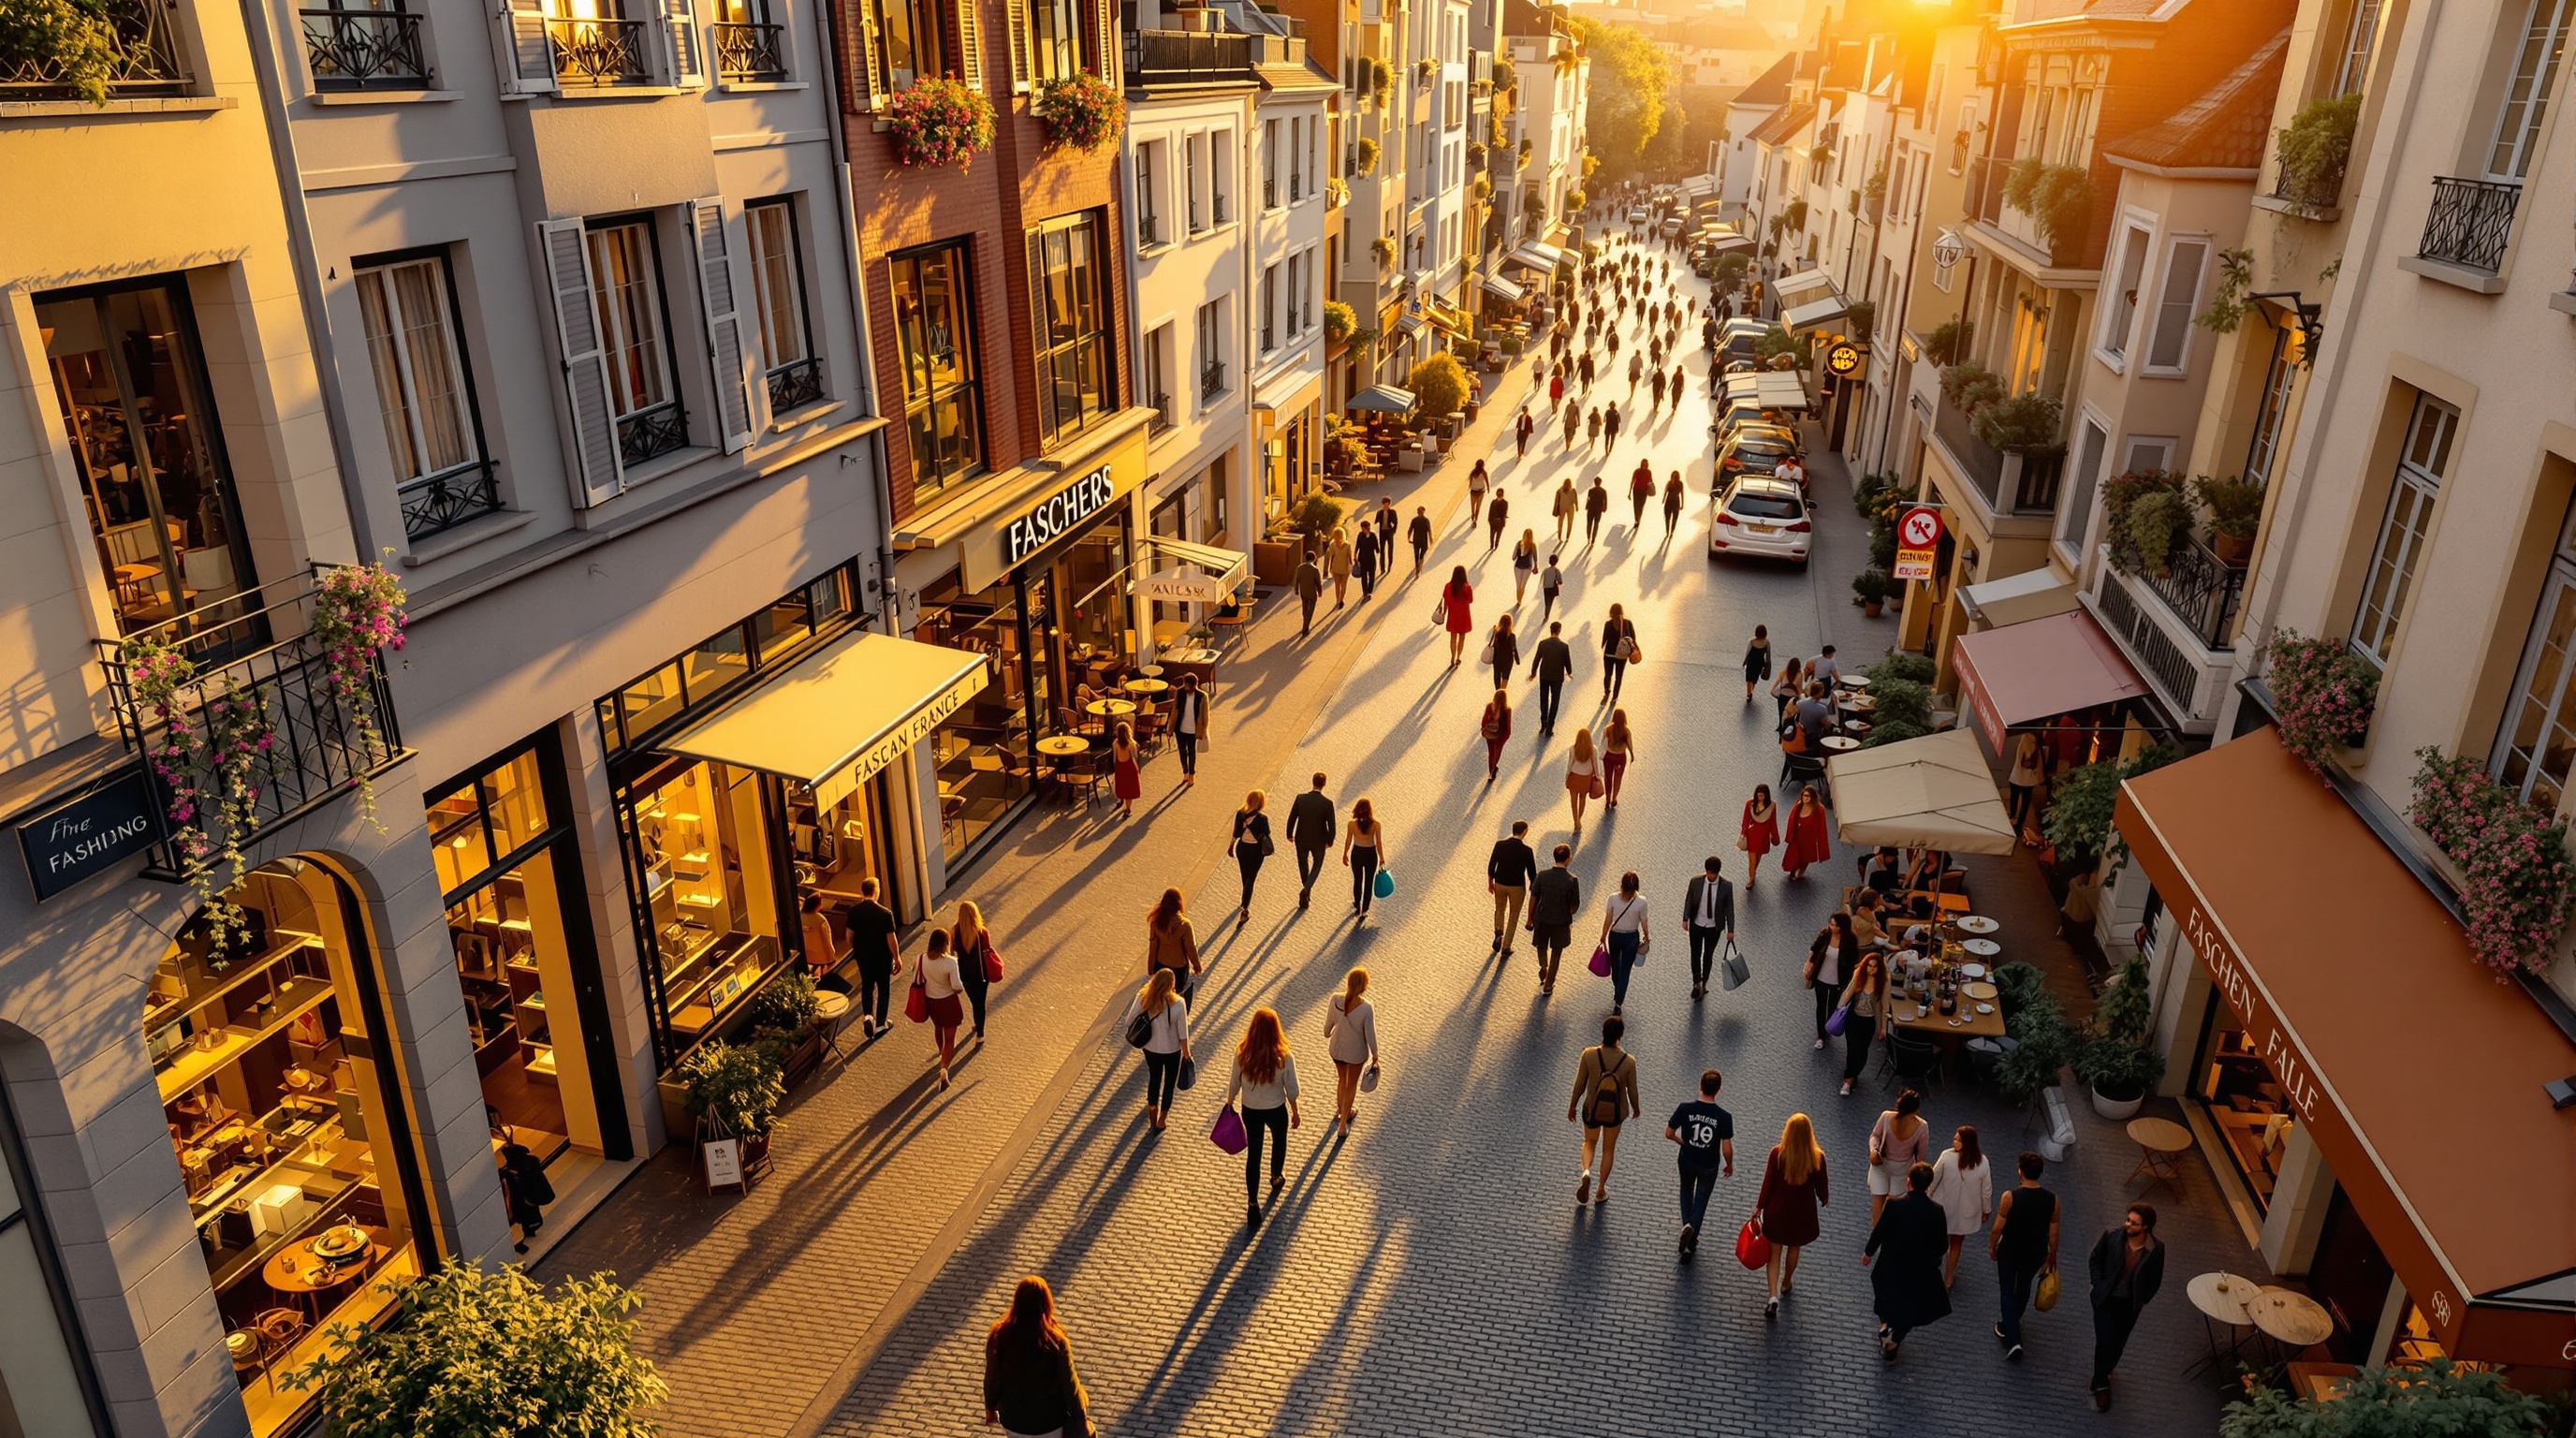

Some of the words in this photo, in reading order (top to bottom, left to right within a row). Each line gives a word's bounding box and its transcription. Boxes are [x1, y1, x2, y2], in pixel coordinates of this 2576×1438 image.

[1010, 463, 1115, 562] FASCHERS
[854, 728, 908, 785] FASCAN
[913, 689, 959, 739] FRANCE
[2188, 905, 2256, 1024] FASCHEN
[2266, 1028, 2319, 1123] FALLE
